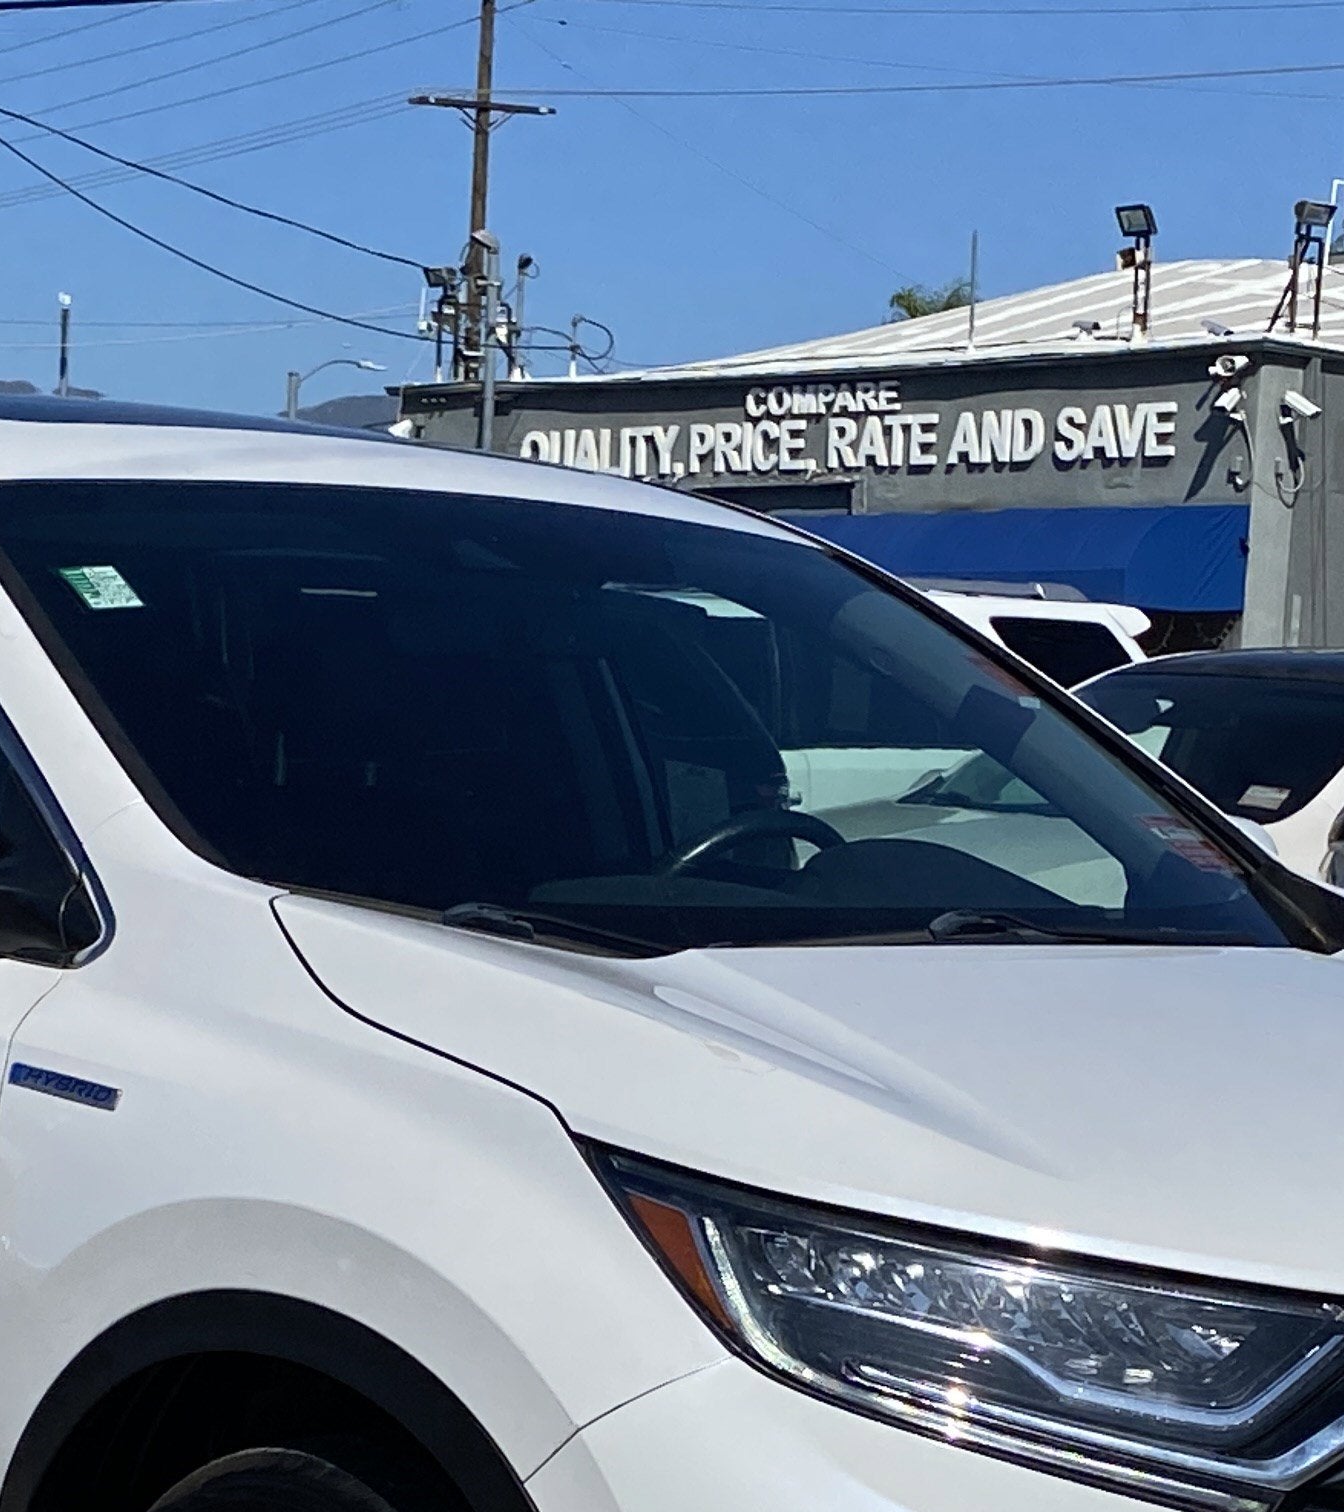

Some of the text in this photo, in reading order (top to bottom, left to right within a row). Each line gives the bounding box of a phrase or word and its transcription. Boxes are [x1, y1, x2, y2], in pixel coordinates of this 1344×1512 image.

[744, 381, 903, 417] COMPARE
[689, 418, 817, 480] PRICE,
[826, 412, 940, 469] RATE
[946, 408, 1046, 465] AND
[1053, 400, 1179, 462] SAVE
